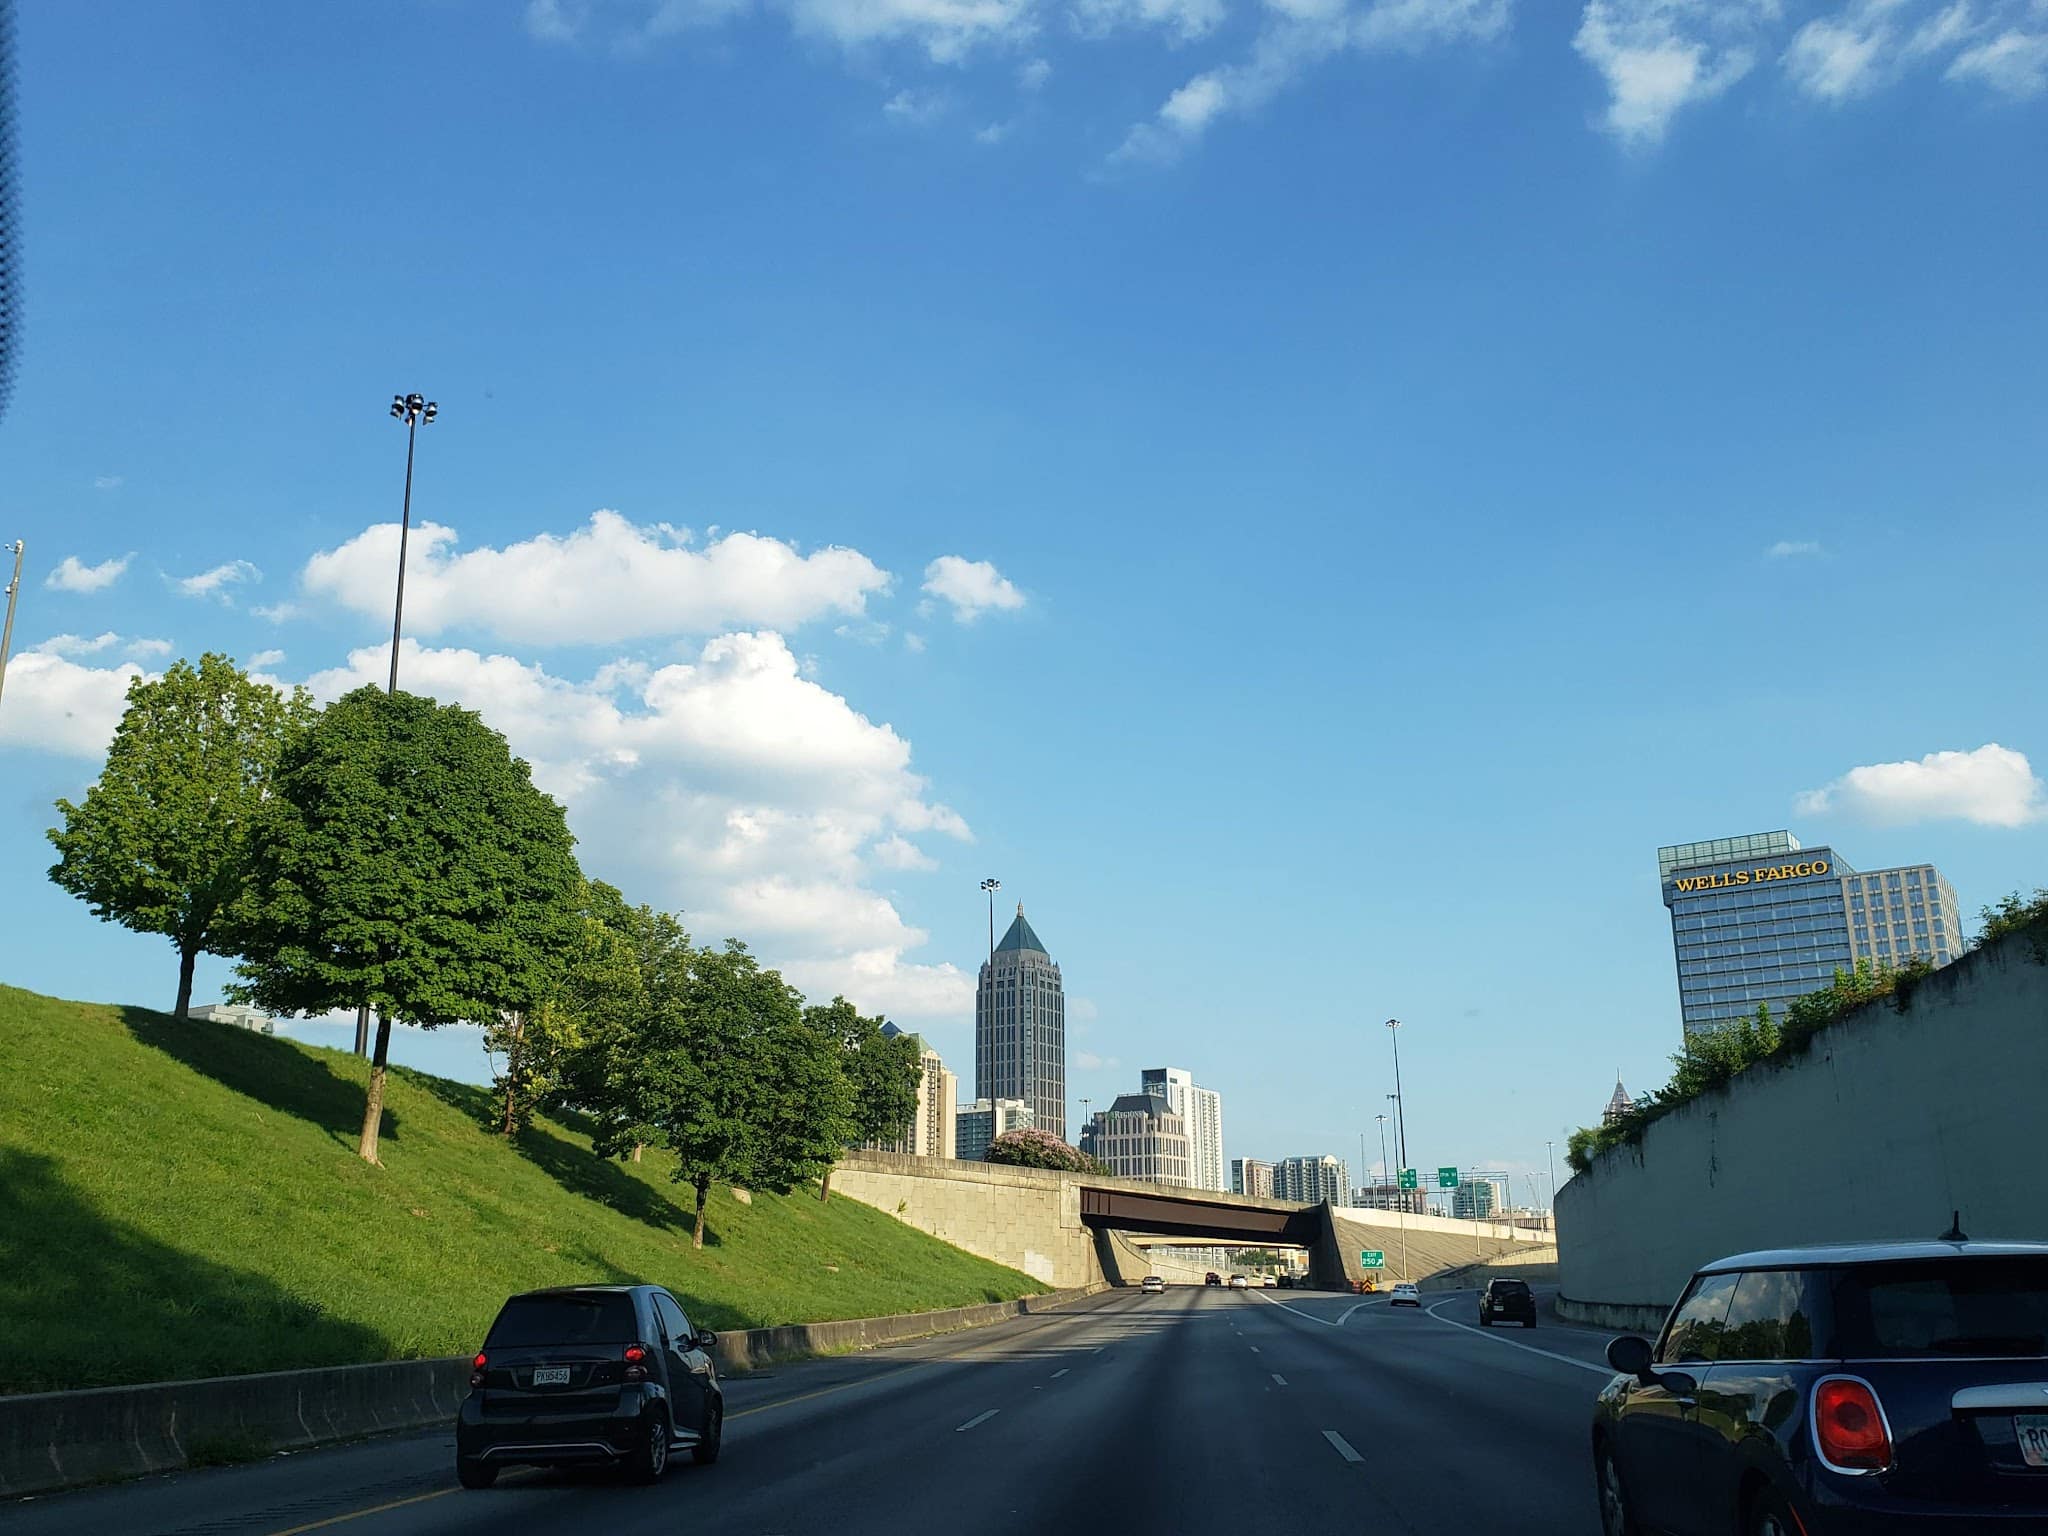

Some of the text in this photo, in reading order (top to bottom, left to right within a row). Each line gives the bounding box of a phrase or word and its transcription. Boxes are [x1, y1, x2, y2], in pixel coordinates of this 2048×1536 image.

[1675, 860, 1829, 893] WELLS FARGO
[1114, 1110, 1145, 1120] REGIONS
